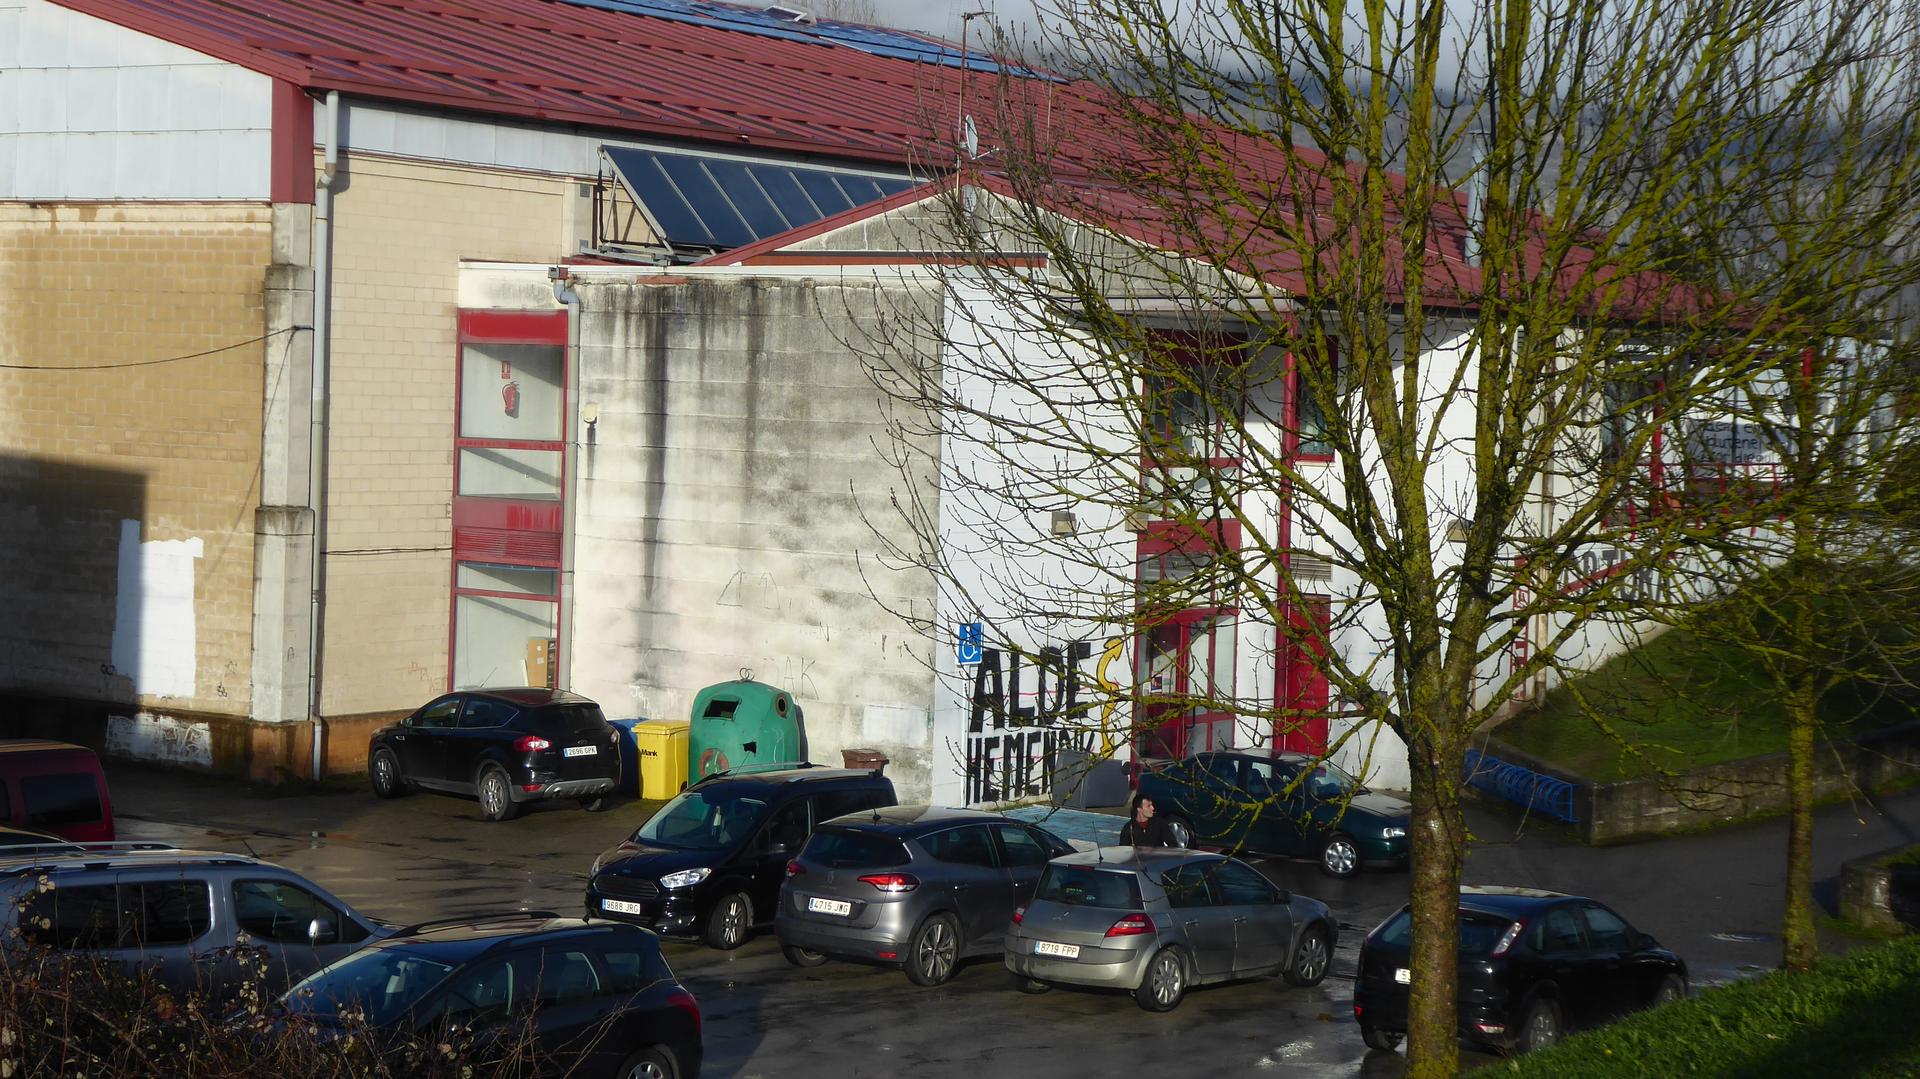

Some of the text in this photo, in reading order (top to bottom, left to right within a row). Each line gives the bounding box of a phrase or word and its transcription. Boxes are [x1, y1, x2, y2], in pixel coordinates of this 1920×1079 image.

[969, 642, 1091, 733] ALDE
[606, 901, 639, 912] 9688 JRG
[814, 900, 832, 910] 4715
[1041, 943, 1077, 955] 8719 FPP
